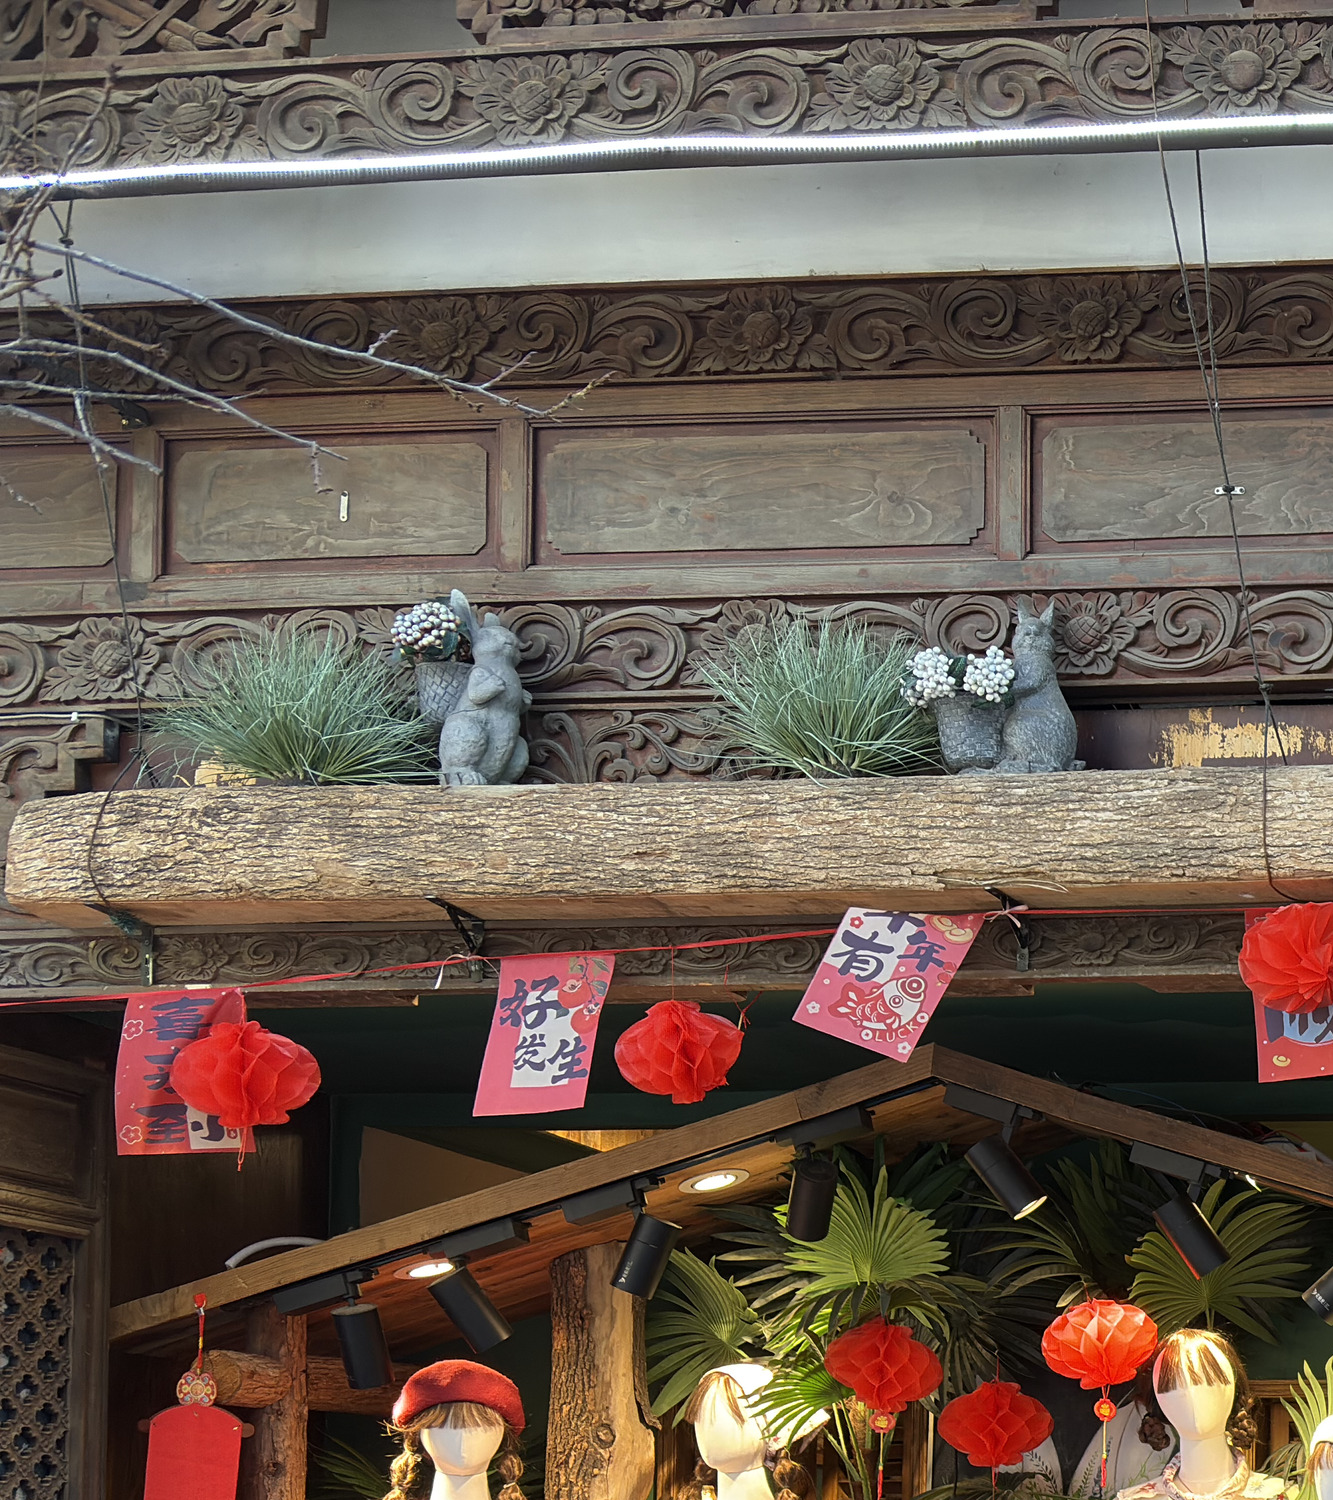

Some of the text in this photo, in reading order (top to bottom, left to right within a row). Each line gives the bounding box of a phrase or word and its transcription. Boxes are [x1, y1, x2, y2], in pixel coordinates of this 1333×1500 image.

[831, 929, 895, 983] 有
[499, 974, 570, 1030] 好
[874, 1021, 919, 1043] LUCK
[513, 1034, 589, 1085] 发生
